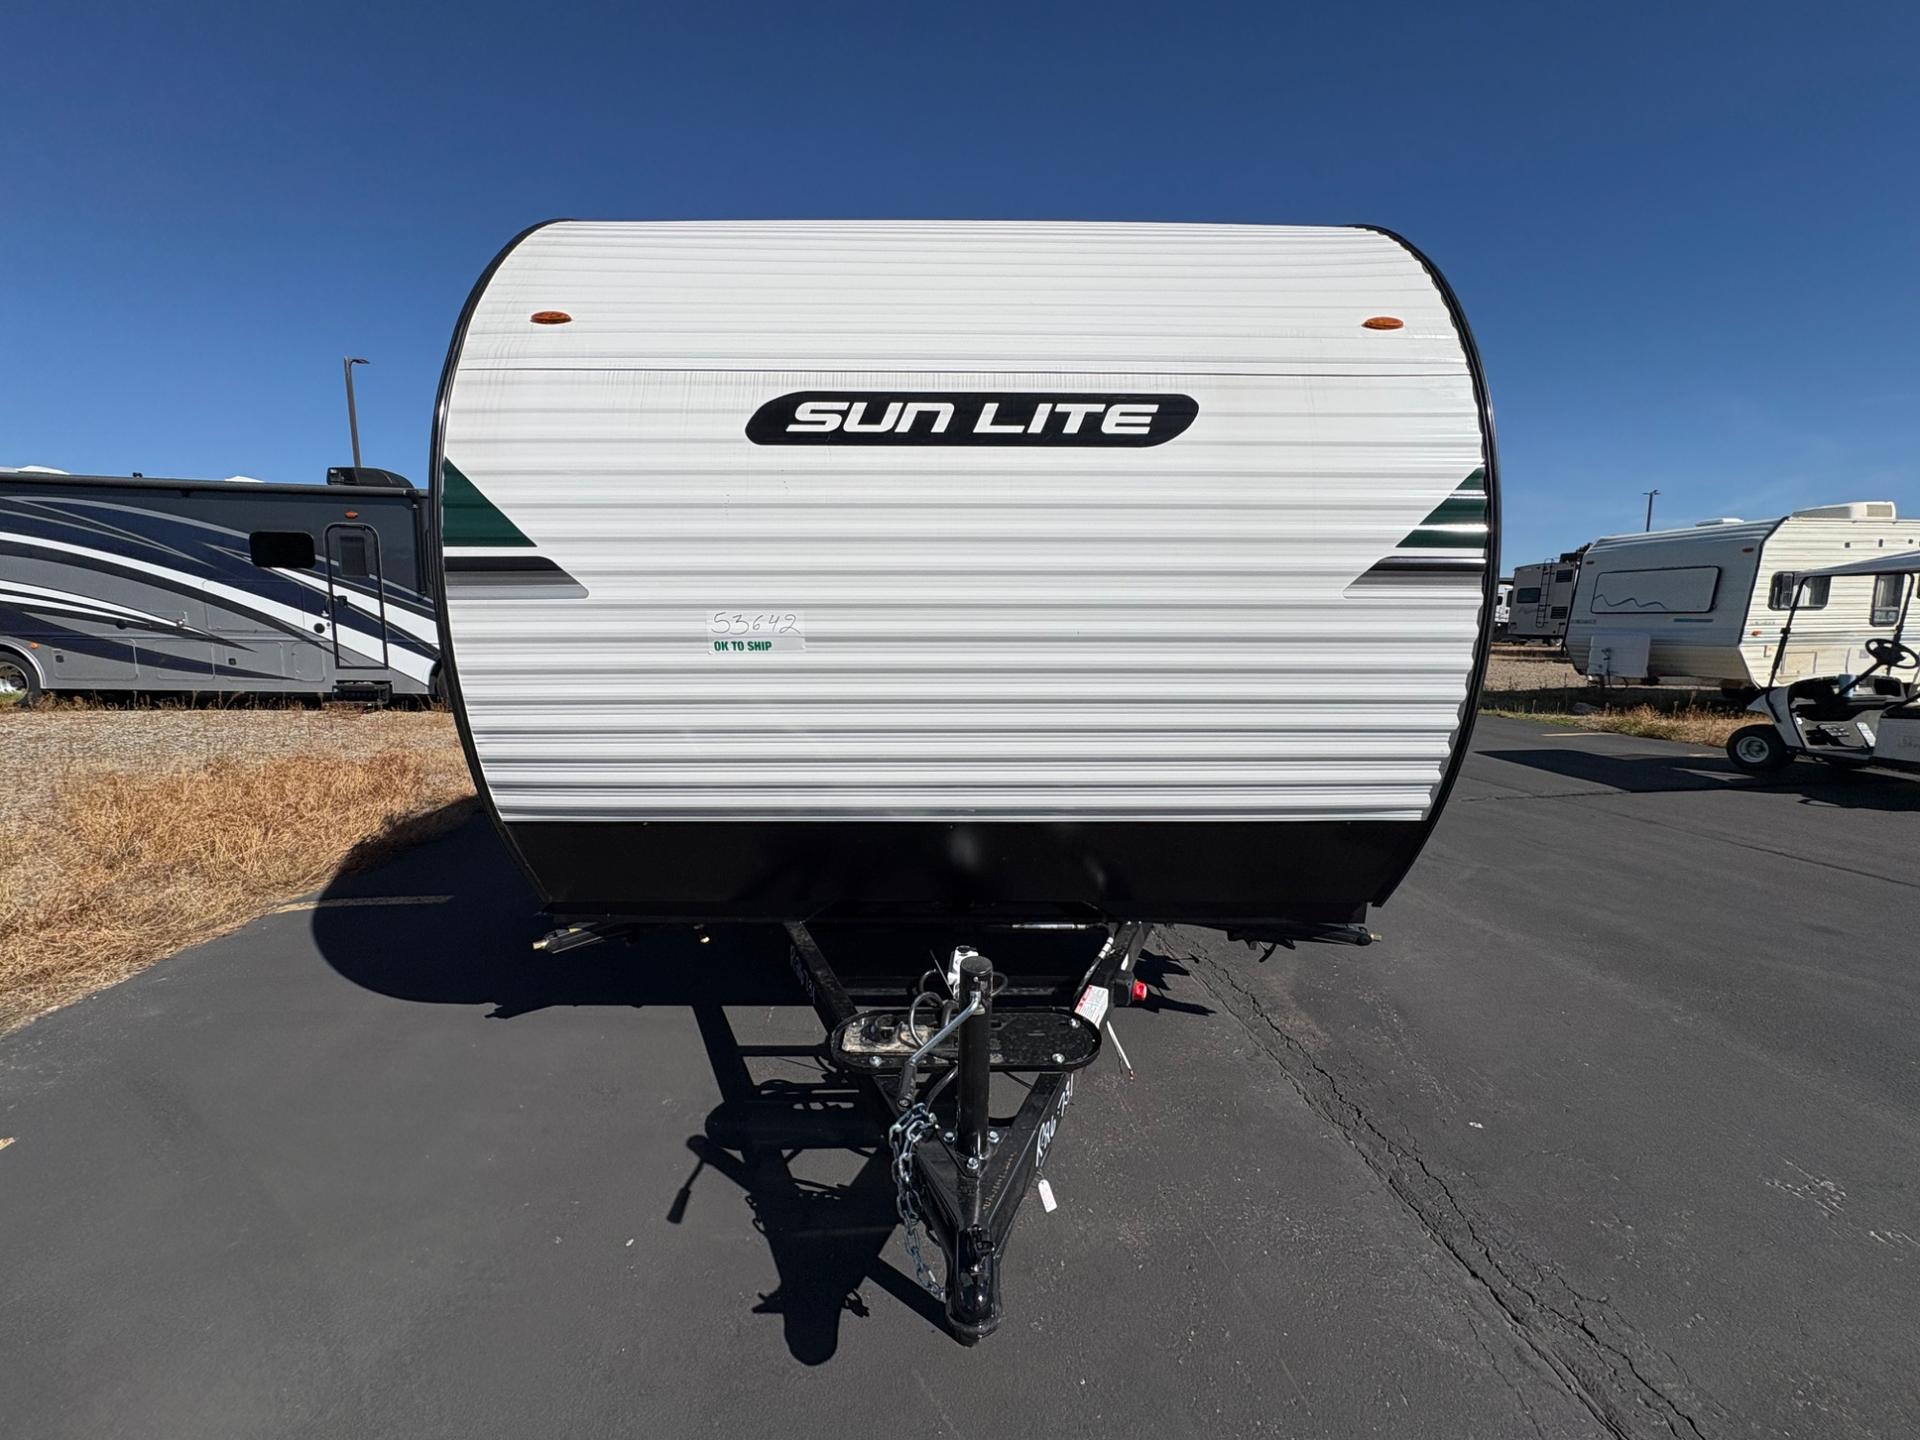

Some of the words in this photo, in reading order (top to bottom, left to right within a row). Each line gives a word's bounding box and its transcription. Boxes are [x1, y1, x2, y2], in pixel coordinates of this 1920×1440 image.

[785, 401, 955, 433] SUN
[973, 402, 1159, 434] LITE
[711, 612, 801, 635] 53642
[714, 641, 729, 652] OK
[731, 641, 745, 652] TO
[747, 641, 772, 652] SHIP
